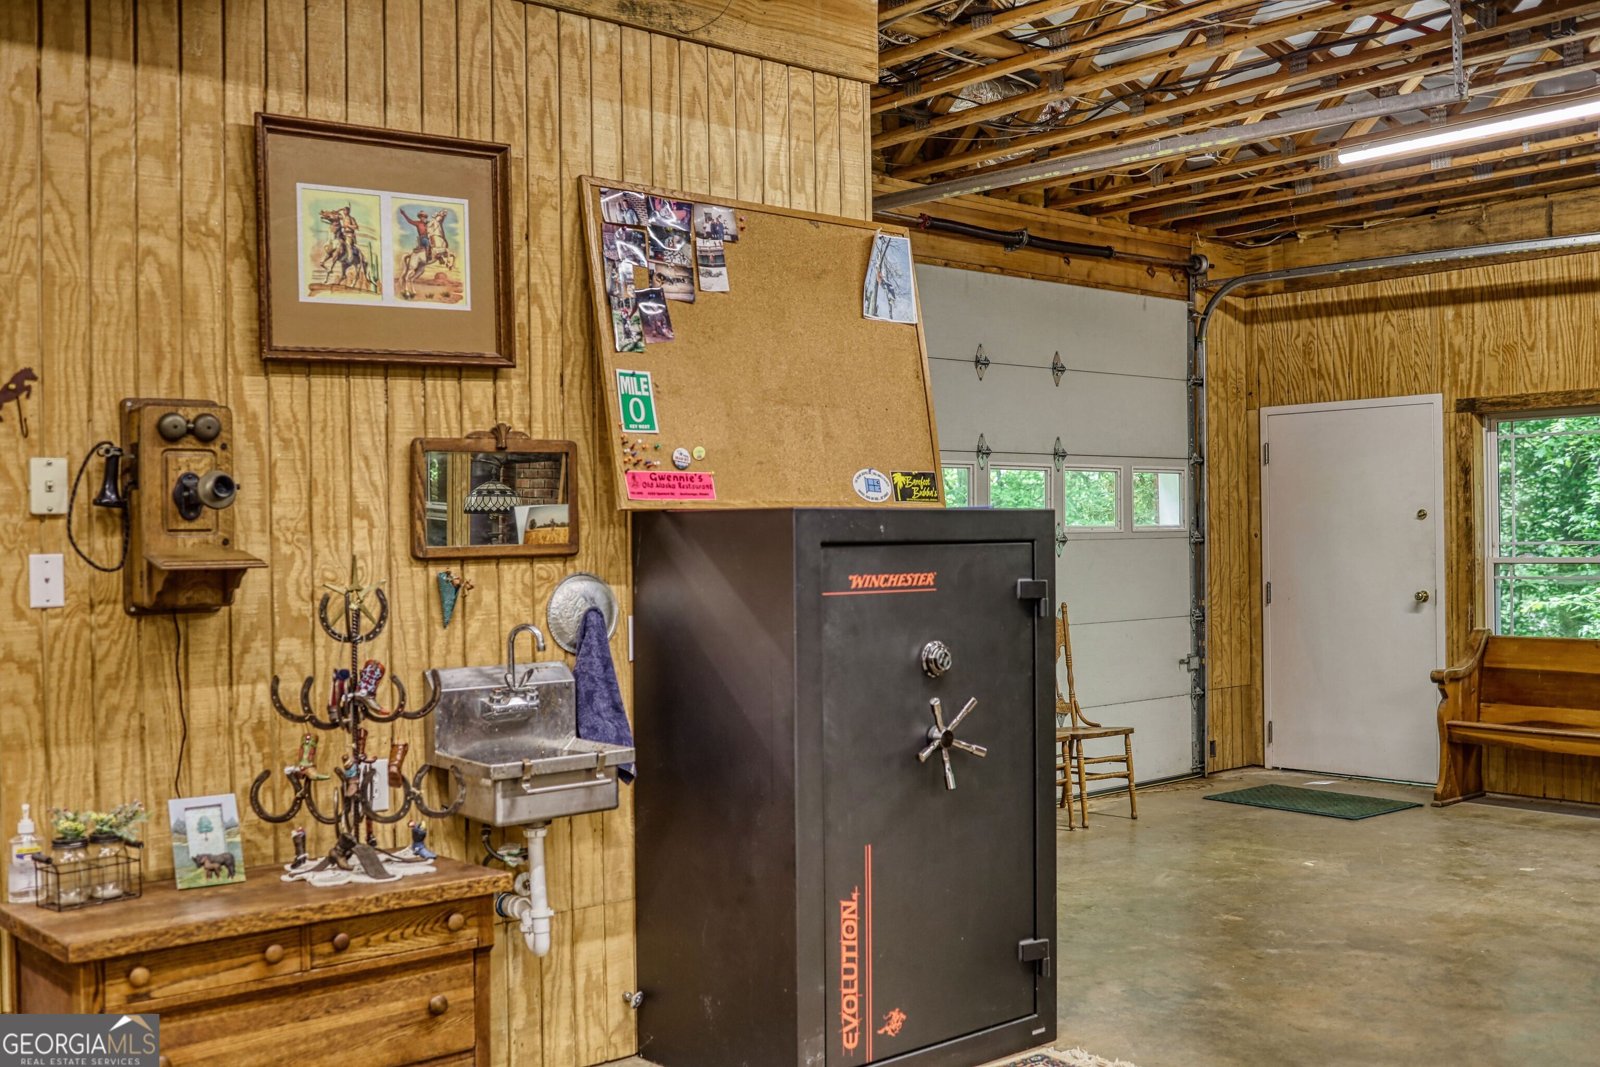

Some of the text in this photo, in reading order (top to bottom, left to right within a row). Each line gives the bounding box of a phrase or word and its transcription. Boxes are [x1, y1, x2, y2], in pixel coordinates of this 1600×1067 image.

[620, 375, 649, 396] MILE
[642, 481, 653, 489] Old
[678, 482, 713, 490] Restaurant
[649, 472, 703, 483] Gwennie's
[848, 572, 936, 589] WINCHESTER
[840, 898, 860, 1053] EVOLUTION
